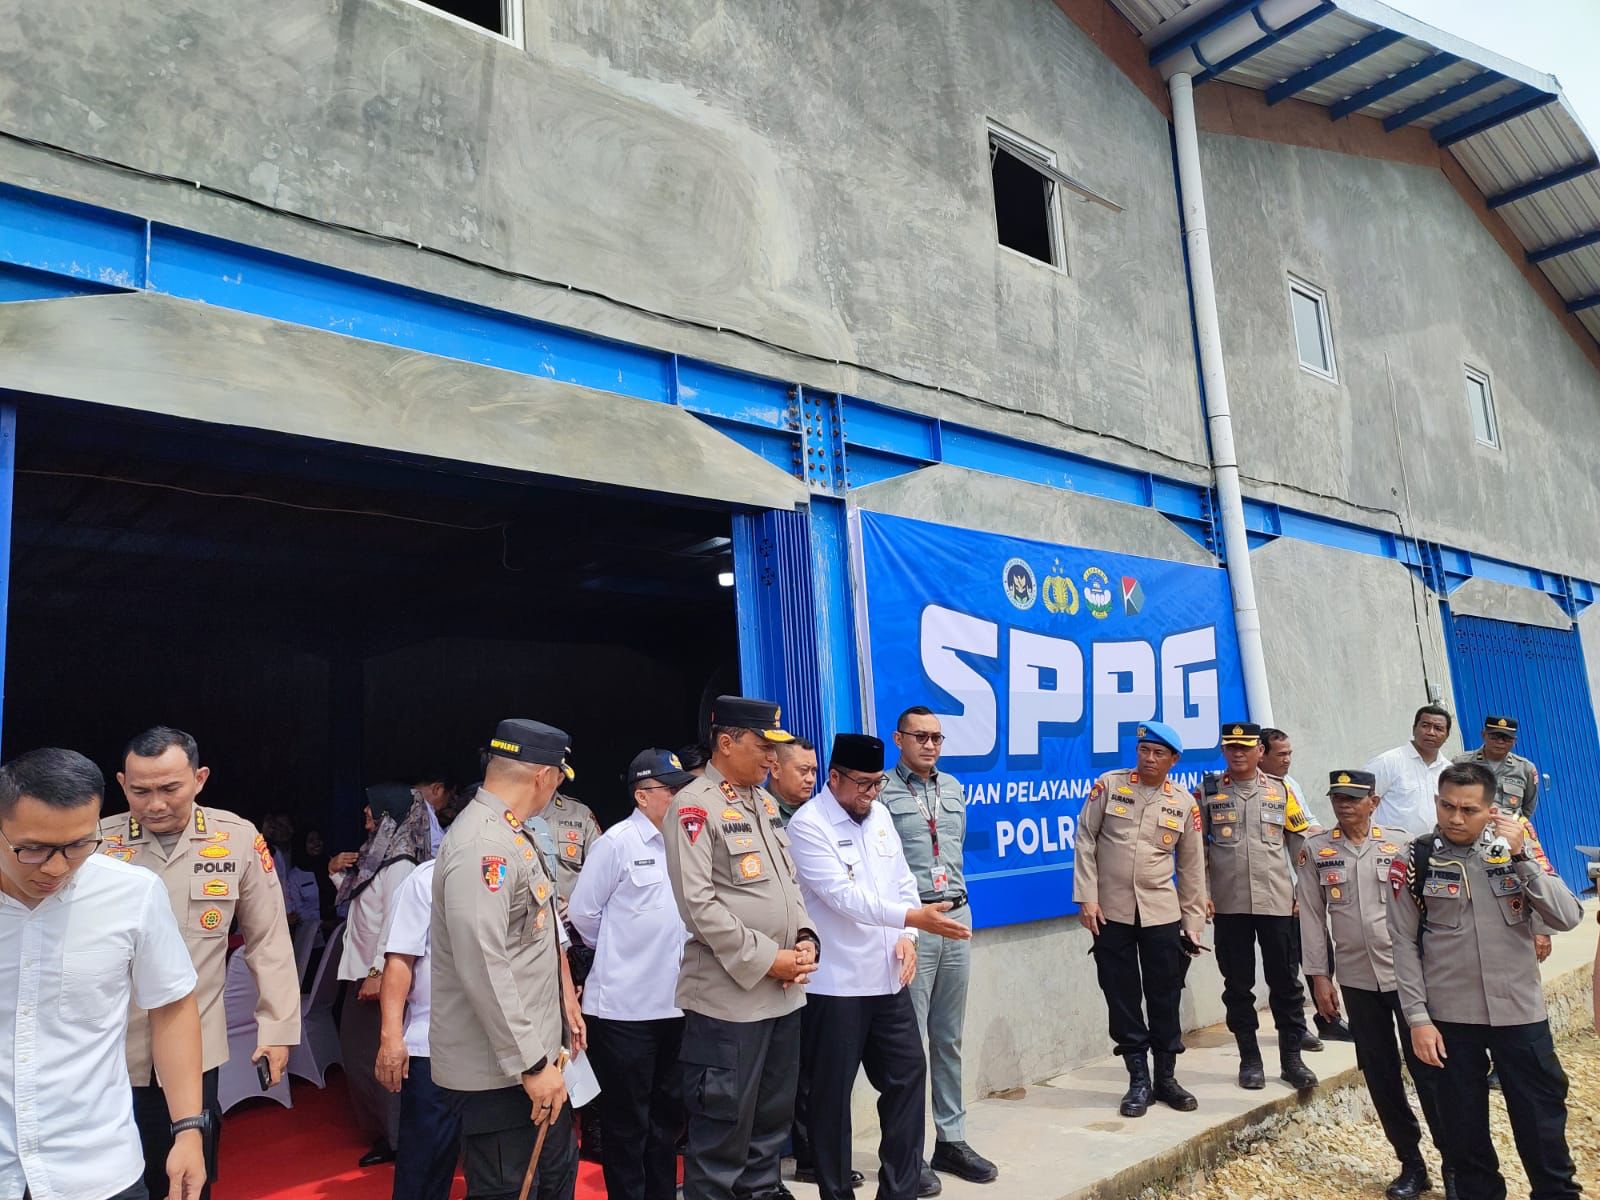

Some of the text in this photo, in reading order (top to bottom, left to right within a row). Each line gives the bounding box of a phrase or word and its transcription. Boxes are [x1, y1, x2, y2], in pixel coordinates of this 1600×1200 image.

[920, 604, 1220, 757] SPPG
[1161, 806, 1184, 817] POLRI
[1262, 802, 1285, 810] POLRI
[996, 815, 1080, 857] POLR
[193, 861, 236, 874] POLRI
